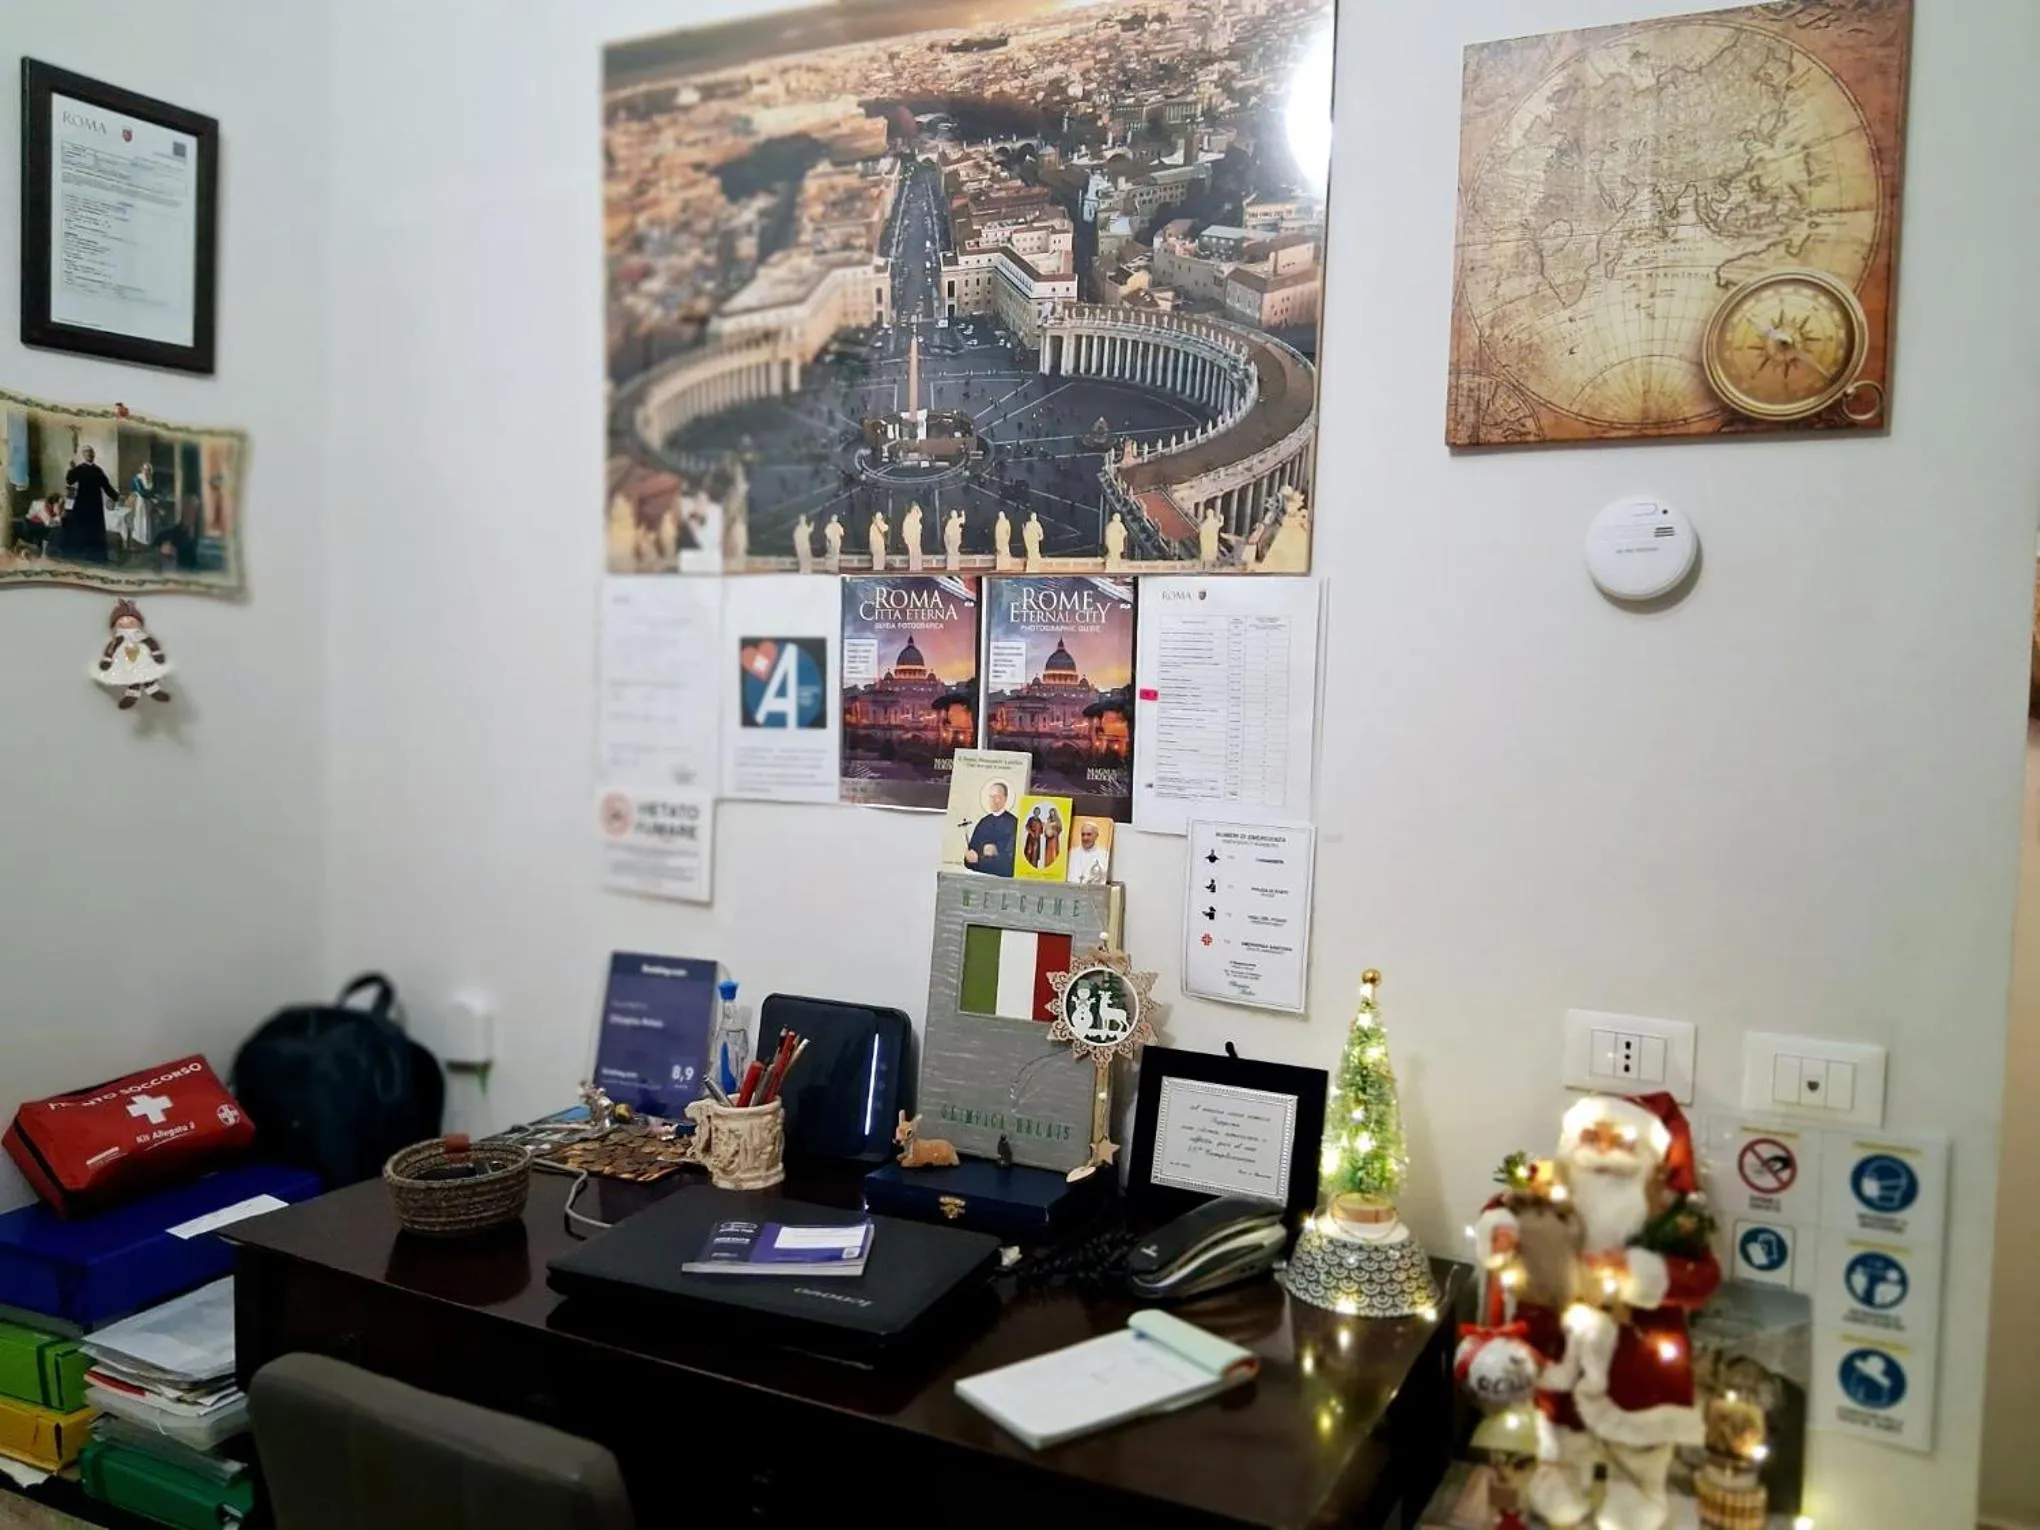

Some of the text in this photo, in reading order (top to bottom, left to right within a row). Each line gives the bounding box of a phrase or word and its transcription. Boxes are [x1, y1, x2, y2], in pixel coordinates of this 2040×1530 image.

[62, 111, 107, 136] ROMA
[875, 587, 944, 608] ROMA
[1022, 588, 1094, 610] ROME
[1162, 590, 1192, 601] ROMA
[906, 603, 958, 621] ETERNA
[1010, 602, 1112, 623] ETERNAL CITY
[962, 889, 1081, 917] WELCOME
[119, 1062, 203, 1095] SOCCORSO
[671, 1064, 695, 1082] 8,9
